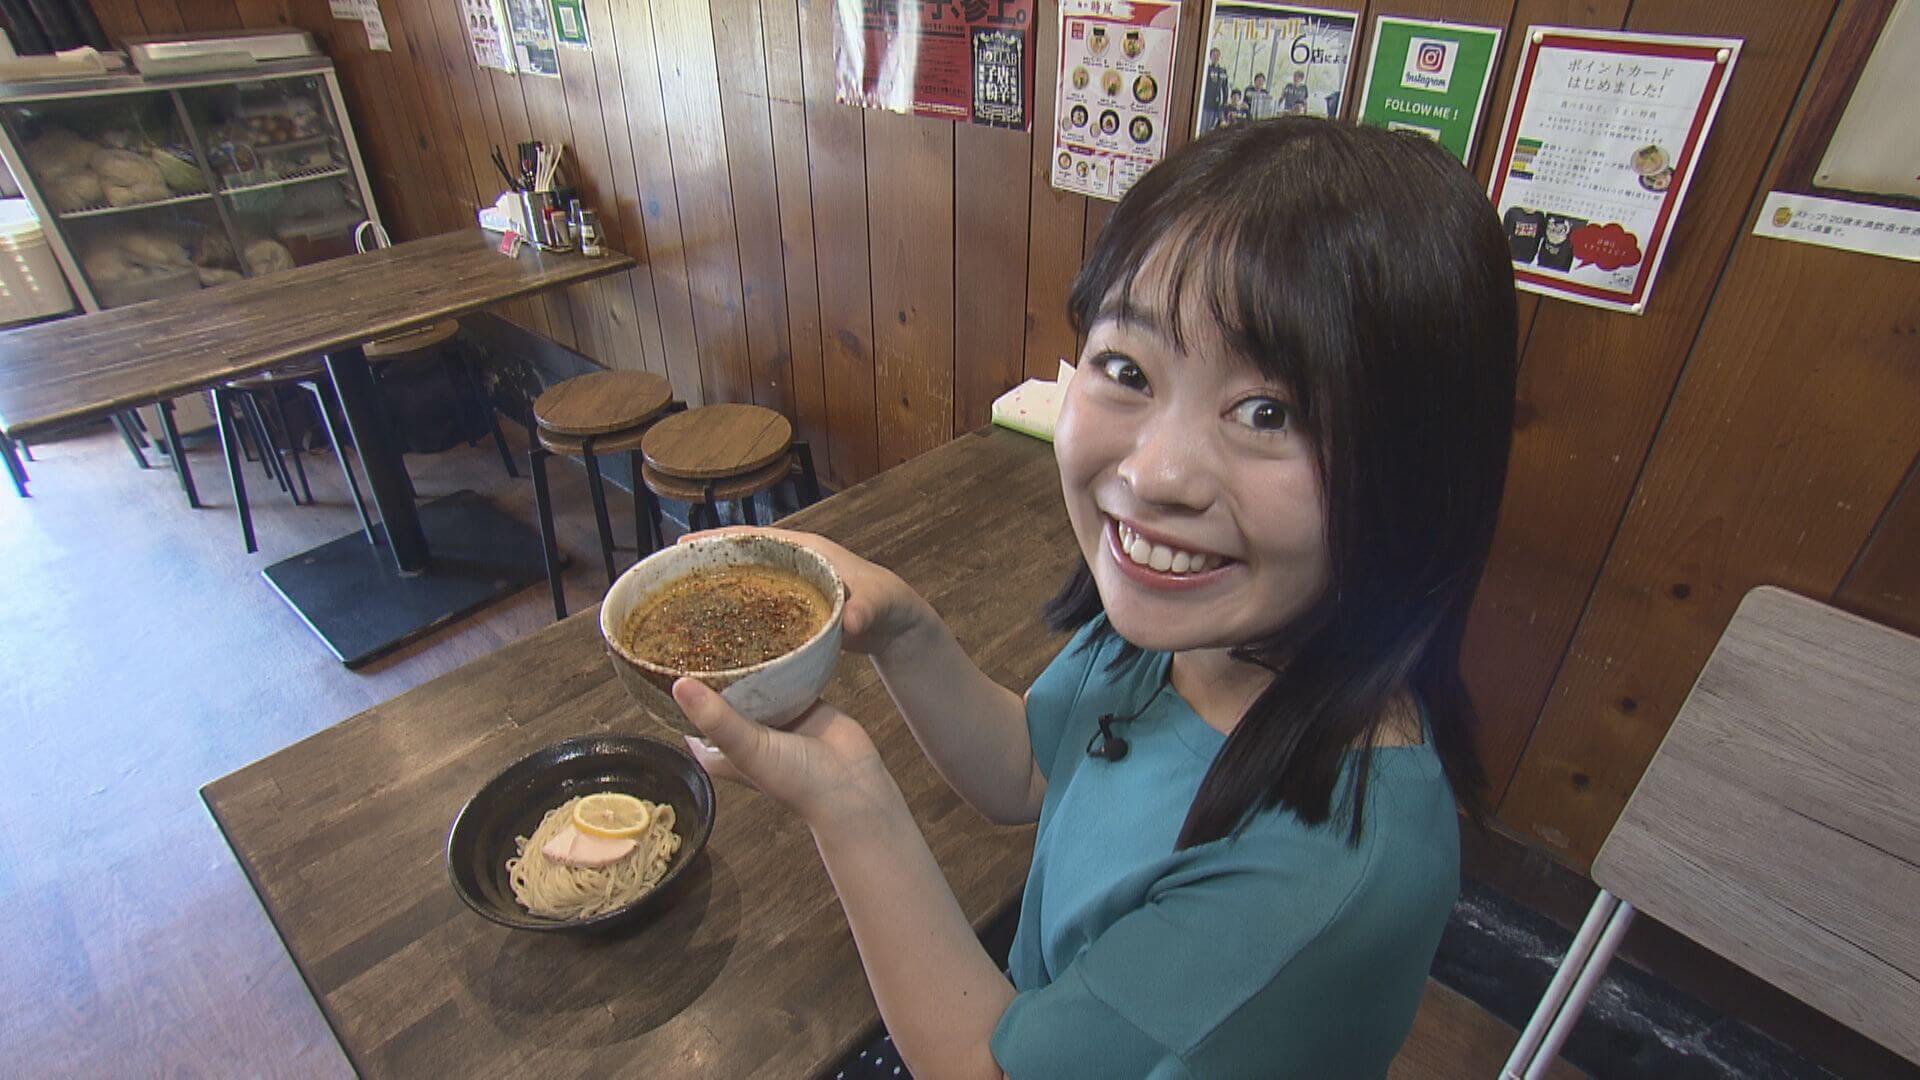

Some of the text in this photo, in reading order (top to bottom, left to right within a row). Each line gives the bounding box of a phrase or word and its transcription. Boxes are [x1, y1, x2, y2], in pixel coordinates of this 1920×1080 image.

[1567, 59, 1675, 80] ポイントカード
[1405, 71, 1446, 88] Instagram
[1384, 98, 1431, 115] FOLLOW
